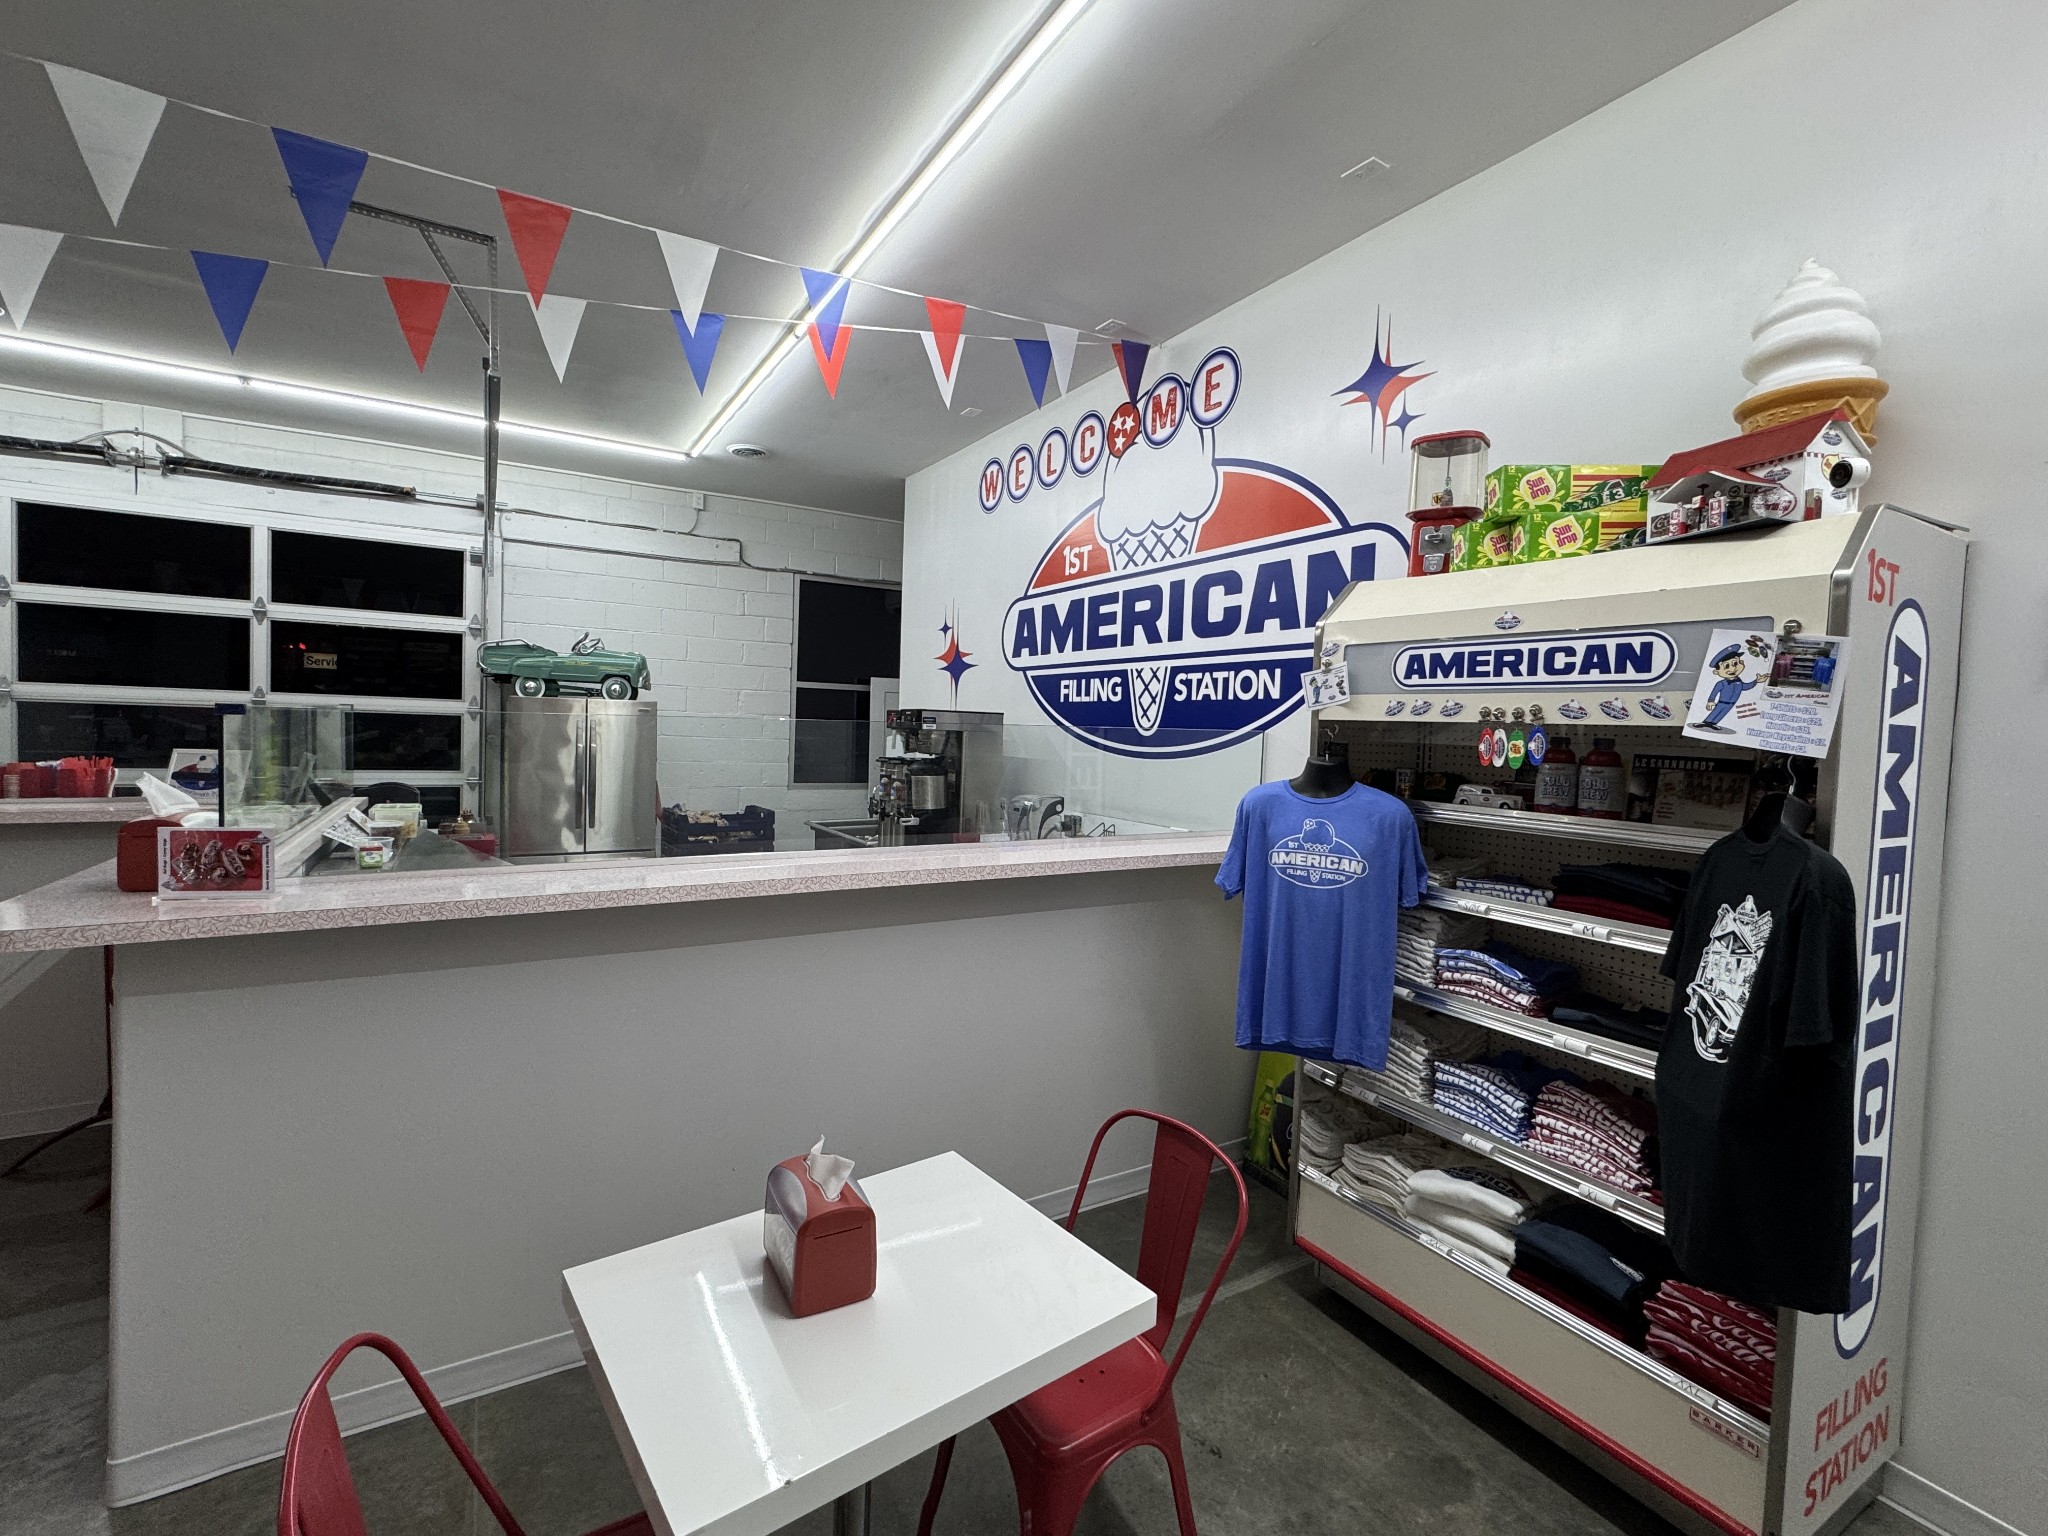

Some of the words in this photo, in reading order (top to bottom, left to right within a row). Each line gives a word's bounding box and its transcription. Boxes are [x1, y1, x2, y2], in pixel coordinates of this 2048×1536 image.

[1530, 484, 1551, 499] drop
[1557, 532, 1578, 548] drop
[1062, 544, 1093, 577] 1ST
[1867, 548, 1900, 607] 1ST
[1012, 543, 1377, 658] AMERICAN
[1403, 641, 1655, 681] AMERICAN
[1059, 676, 1122, 703] FILLING
[1174, 668, 1282, 702] STATION
[1271, 851, 1364, 874] AMERICAN
[1286, 868, 1308, 877] FILLING
[1321, 872, 1346, 881] STATION
[1842, 634, 1922, 1319] AMERICAN
[1675, 1377, 1706, 1401] XXL
[1814, 1358, 1888, 1452] FILLING
[1804, 1405, 1890, 1517] STATION
